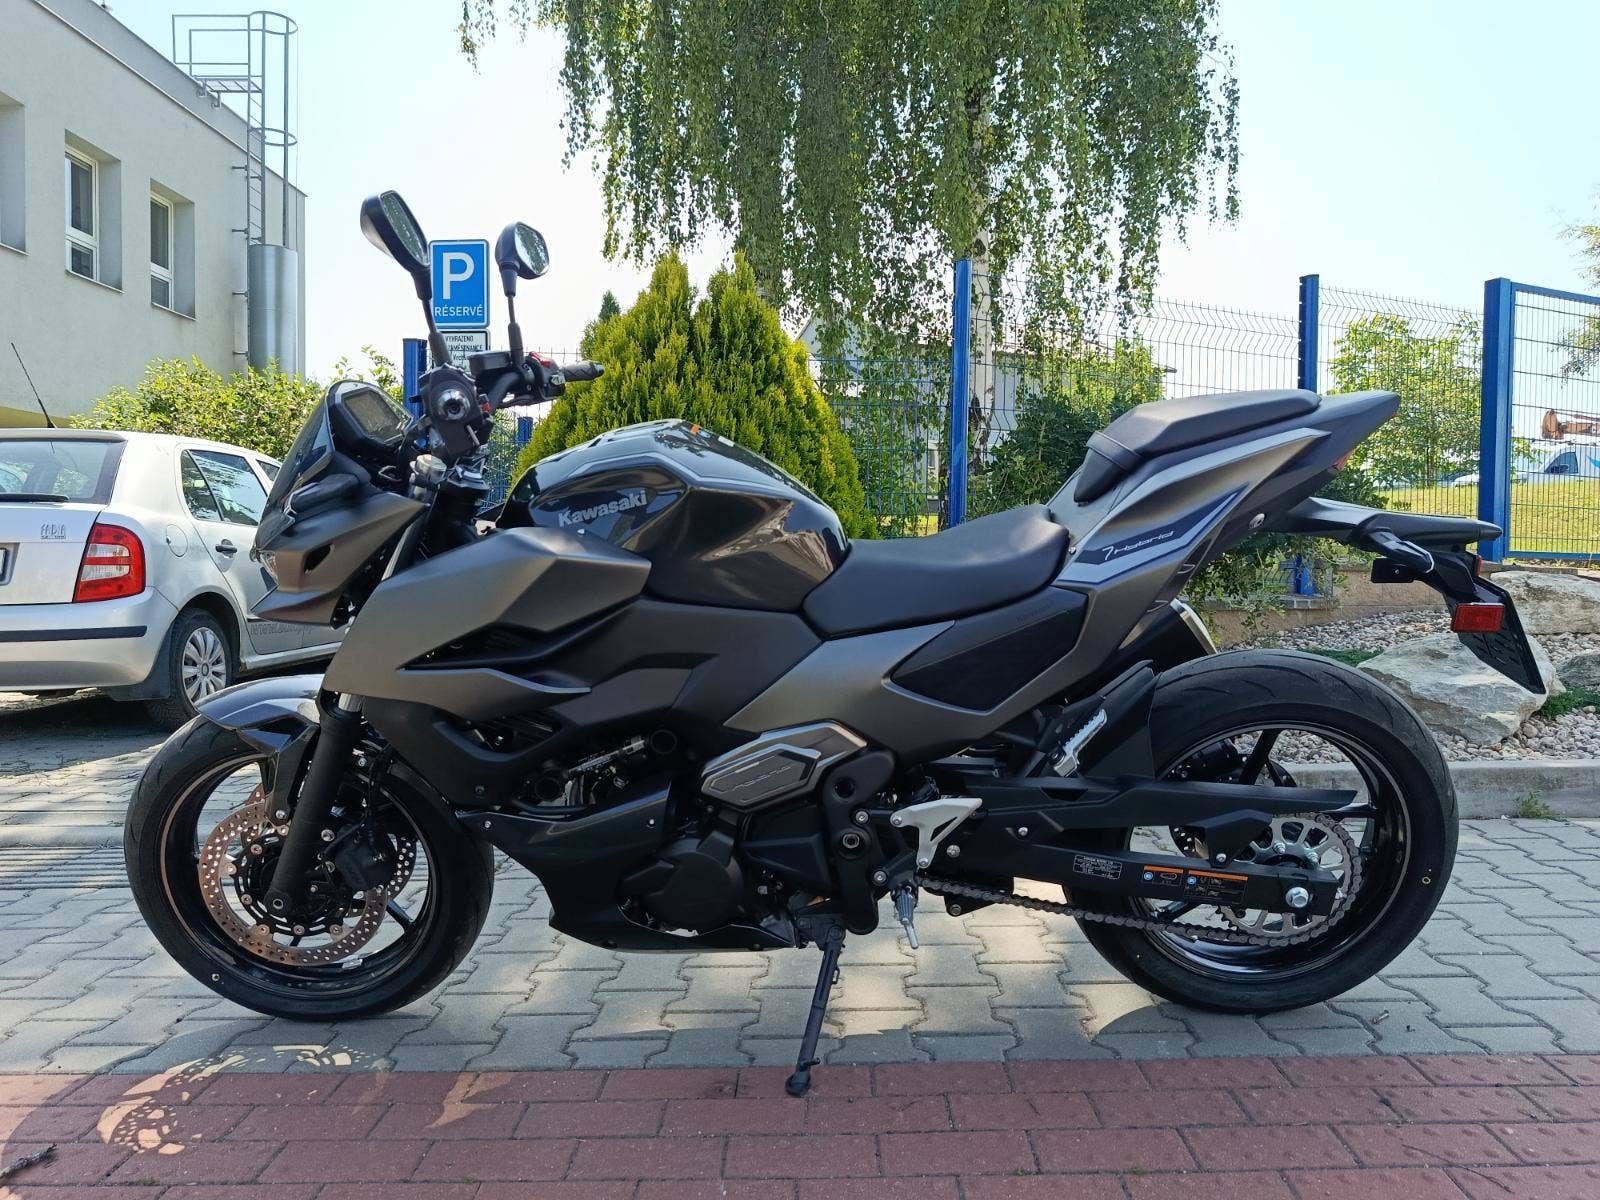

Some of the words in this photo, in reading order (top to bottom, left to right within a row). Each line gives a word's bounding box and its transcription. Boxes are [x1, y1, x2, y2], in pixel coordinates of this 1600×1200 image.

[442, 252, 475, 300] P
[434, 303, 483, 317] RÉSERVÉ
[558, 489, 648, 528] Kawasaki
[1102, 546, 1115, 561] 7
